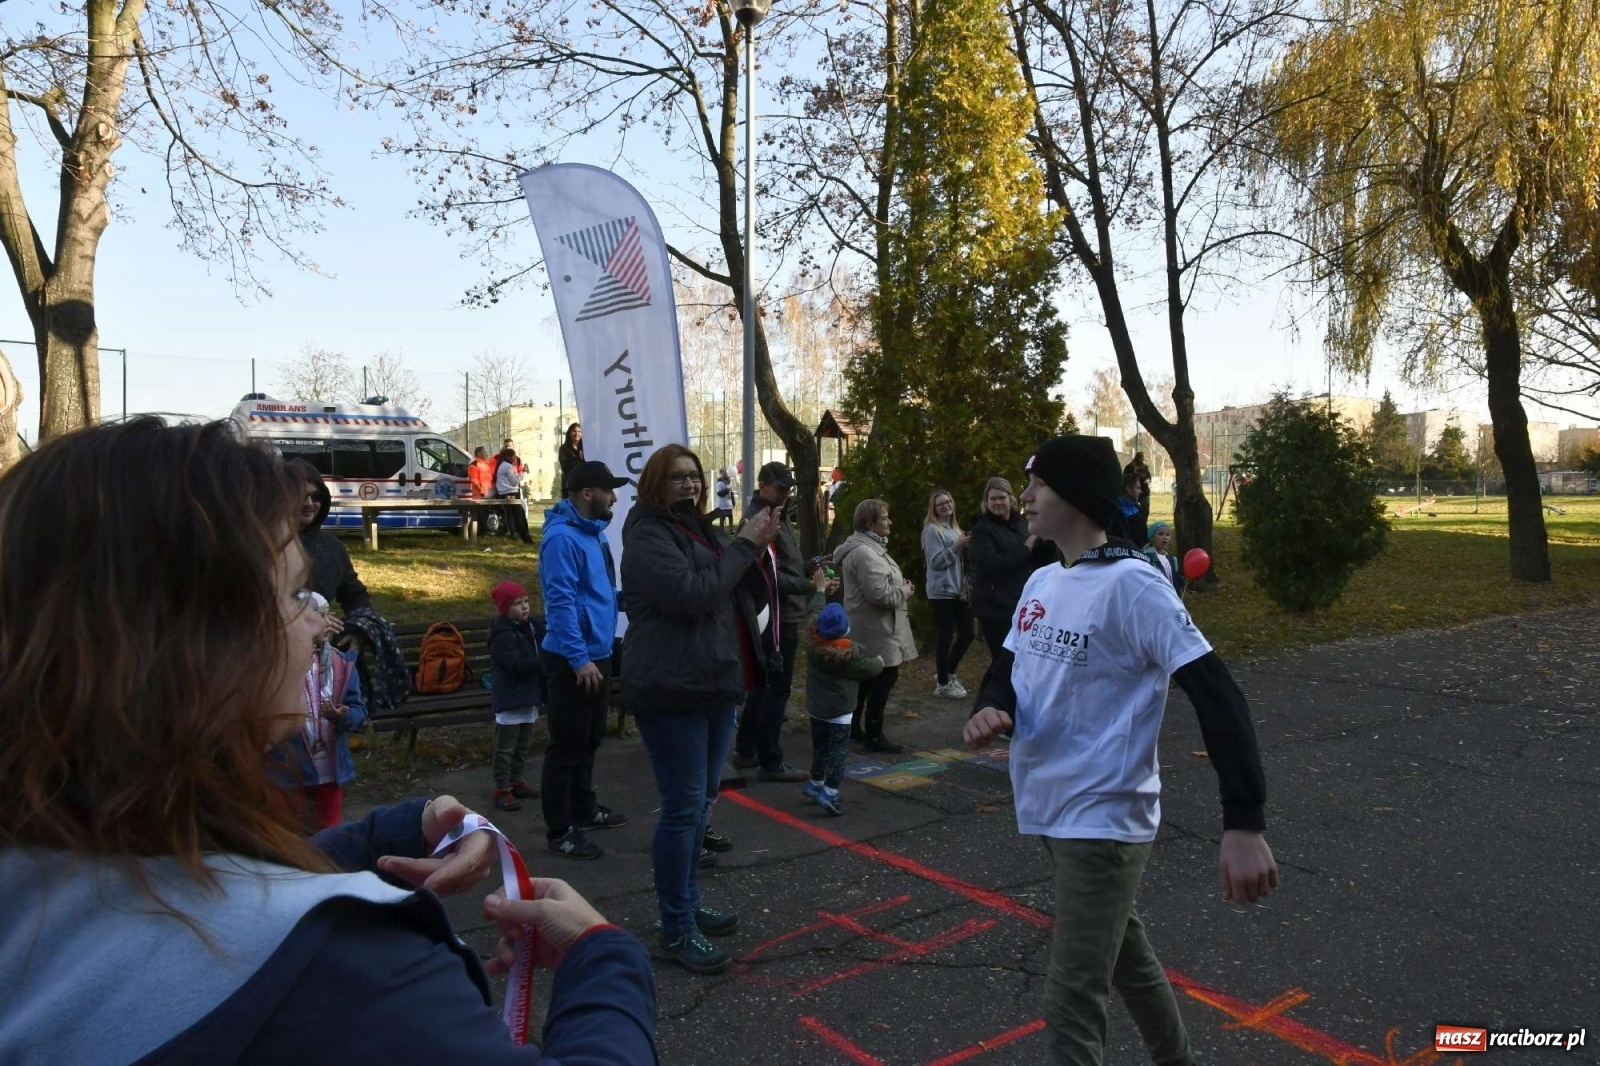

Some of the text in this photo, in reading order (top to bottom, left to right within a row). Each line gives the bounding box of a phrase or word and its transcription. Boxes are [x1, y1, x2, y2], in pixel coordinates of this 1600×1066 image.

[256, 403, 307, 413] AMBULANS
[1103, 546, 1130, 558] VANDAL
[1056, 628, 1089, 649] 2021
